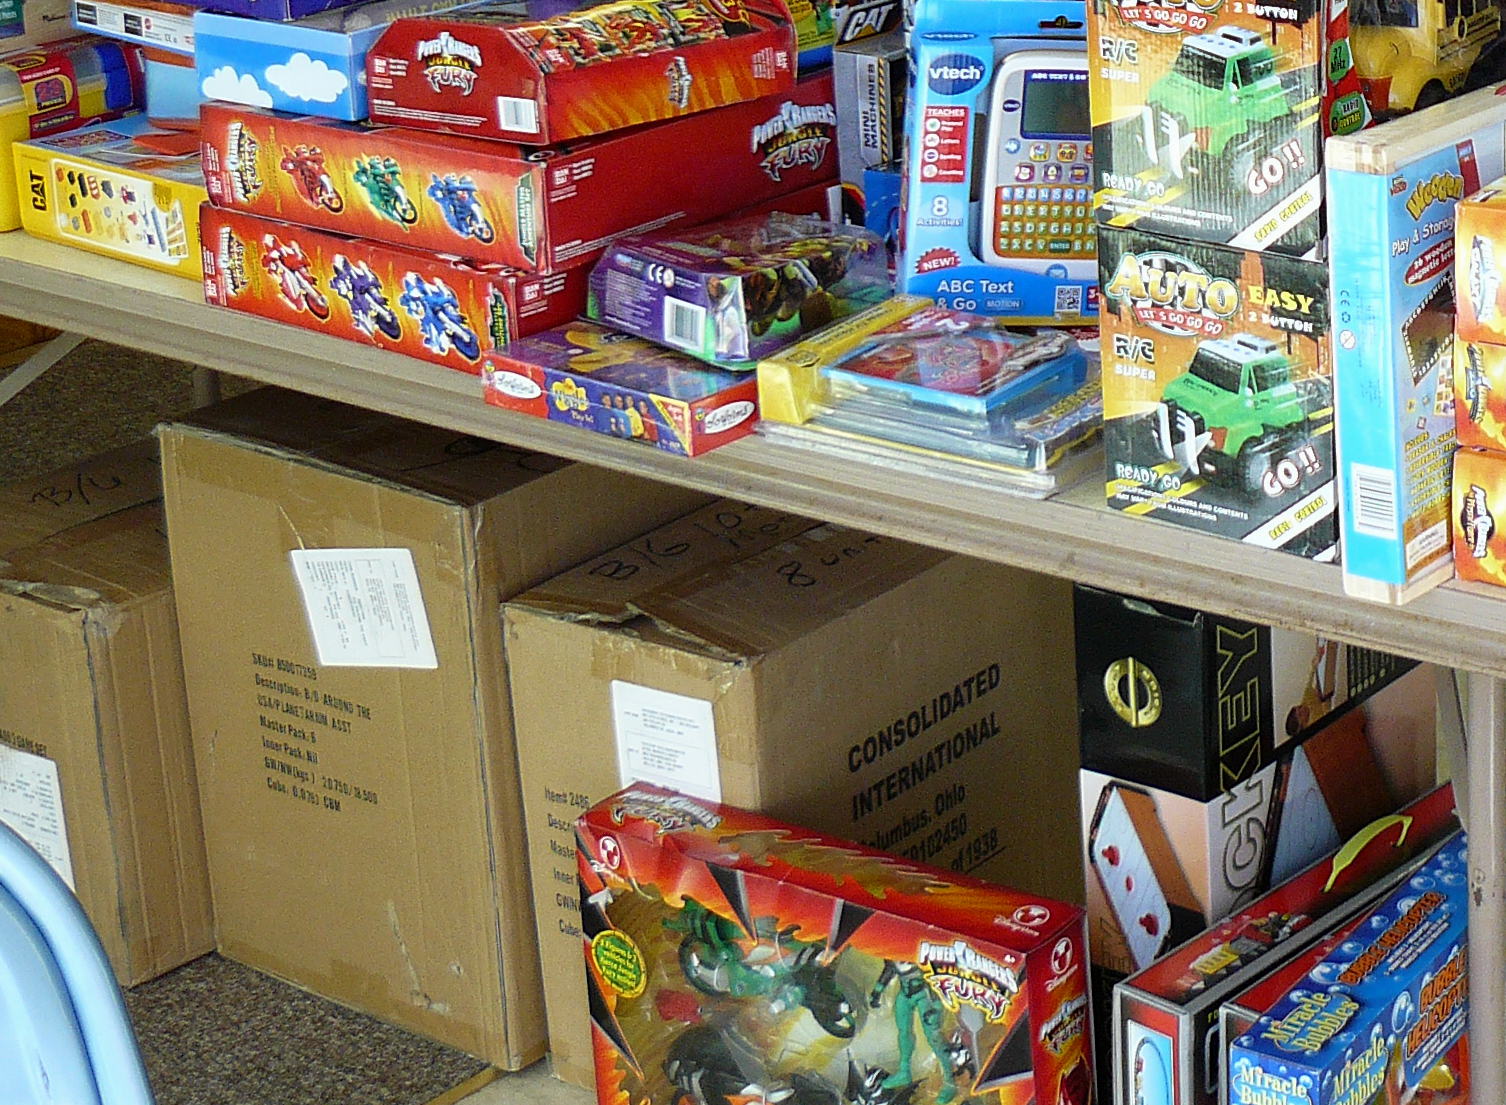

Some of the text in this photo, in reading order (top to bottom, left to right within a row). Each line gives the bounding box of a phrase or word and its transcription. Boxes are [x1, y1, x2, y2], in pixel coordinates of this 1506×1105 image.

[845, 0, 897, 36] CAT
[1233, 2, 1298, 21] 2 BUTTON
[1101, 37, 1139, 65] R/C
[928, 64, 983, 82] vtech
[1100, 68, 1140, 85] SUPER
[787, 103, 838, 133] RANGERS
[868, 63, 878, 150] MACHINES
[927, 107, 966, 117] TEACHES
[768, 126, 824, 152] JUNGLE
[864, 108, 873, 149] MINI
[759, 137, 832, 182] FURY
[32, 169, 47, 213] CAT
[1102, 171, 1142, 192] READY
[931, 195, 949, 216] 8
[1405, 175, 1465, 222] Wooden
[1391, 231, 1411, 258] Play
[921, 255, 956, 272] NEW!
[937, 278, 1014, 294] ABC Text
[1106, 254, 1315, 318] AUTO EASY
[953, 298, 977, 311] Go
[1204, 318, 1224, 335] GO
[1261, 314, 1314, 333] BUTTON
[1114, 363, 1156, 382] SUPER
[1115, 461, 1182, 492] READY GO
[323, 693, 372, 720] AROUND THE
[848, 662, 1000, 773] CONSOLIDATED
[259, 714, 287, 735] Master
[332, 718, 352, 734] ASST
[262, 735, 283, 752] Inner
[851, 710, 1001, 823] INTERNATIONAL
[935, 782, 966, 817] Ohio
[967, 826, 999, 866] 1938
[1338, 891, 1447, 986] BUBBLE HELICOPTER
[918, 939, 952, 972] POWER
[931, 975, 1009, 1020] FURY
[1261, 991, 1332, 1043] Miracle
[1294, 999, 1360, 1052] Bubbles
[1240, 1065, 1308, 1098] Miracle
[1333, 1036, 1386, 1098] Miracle
